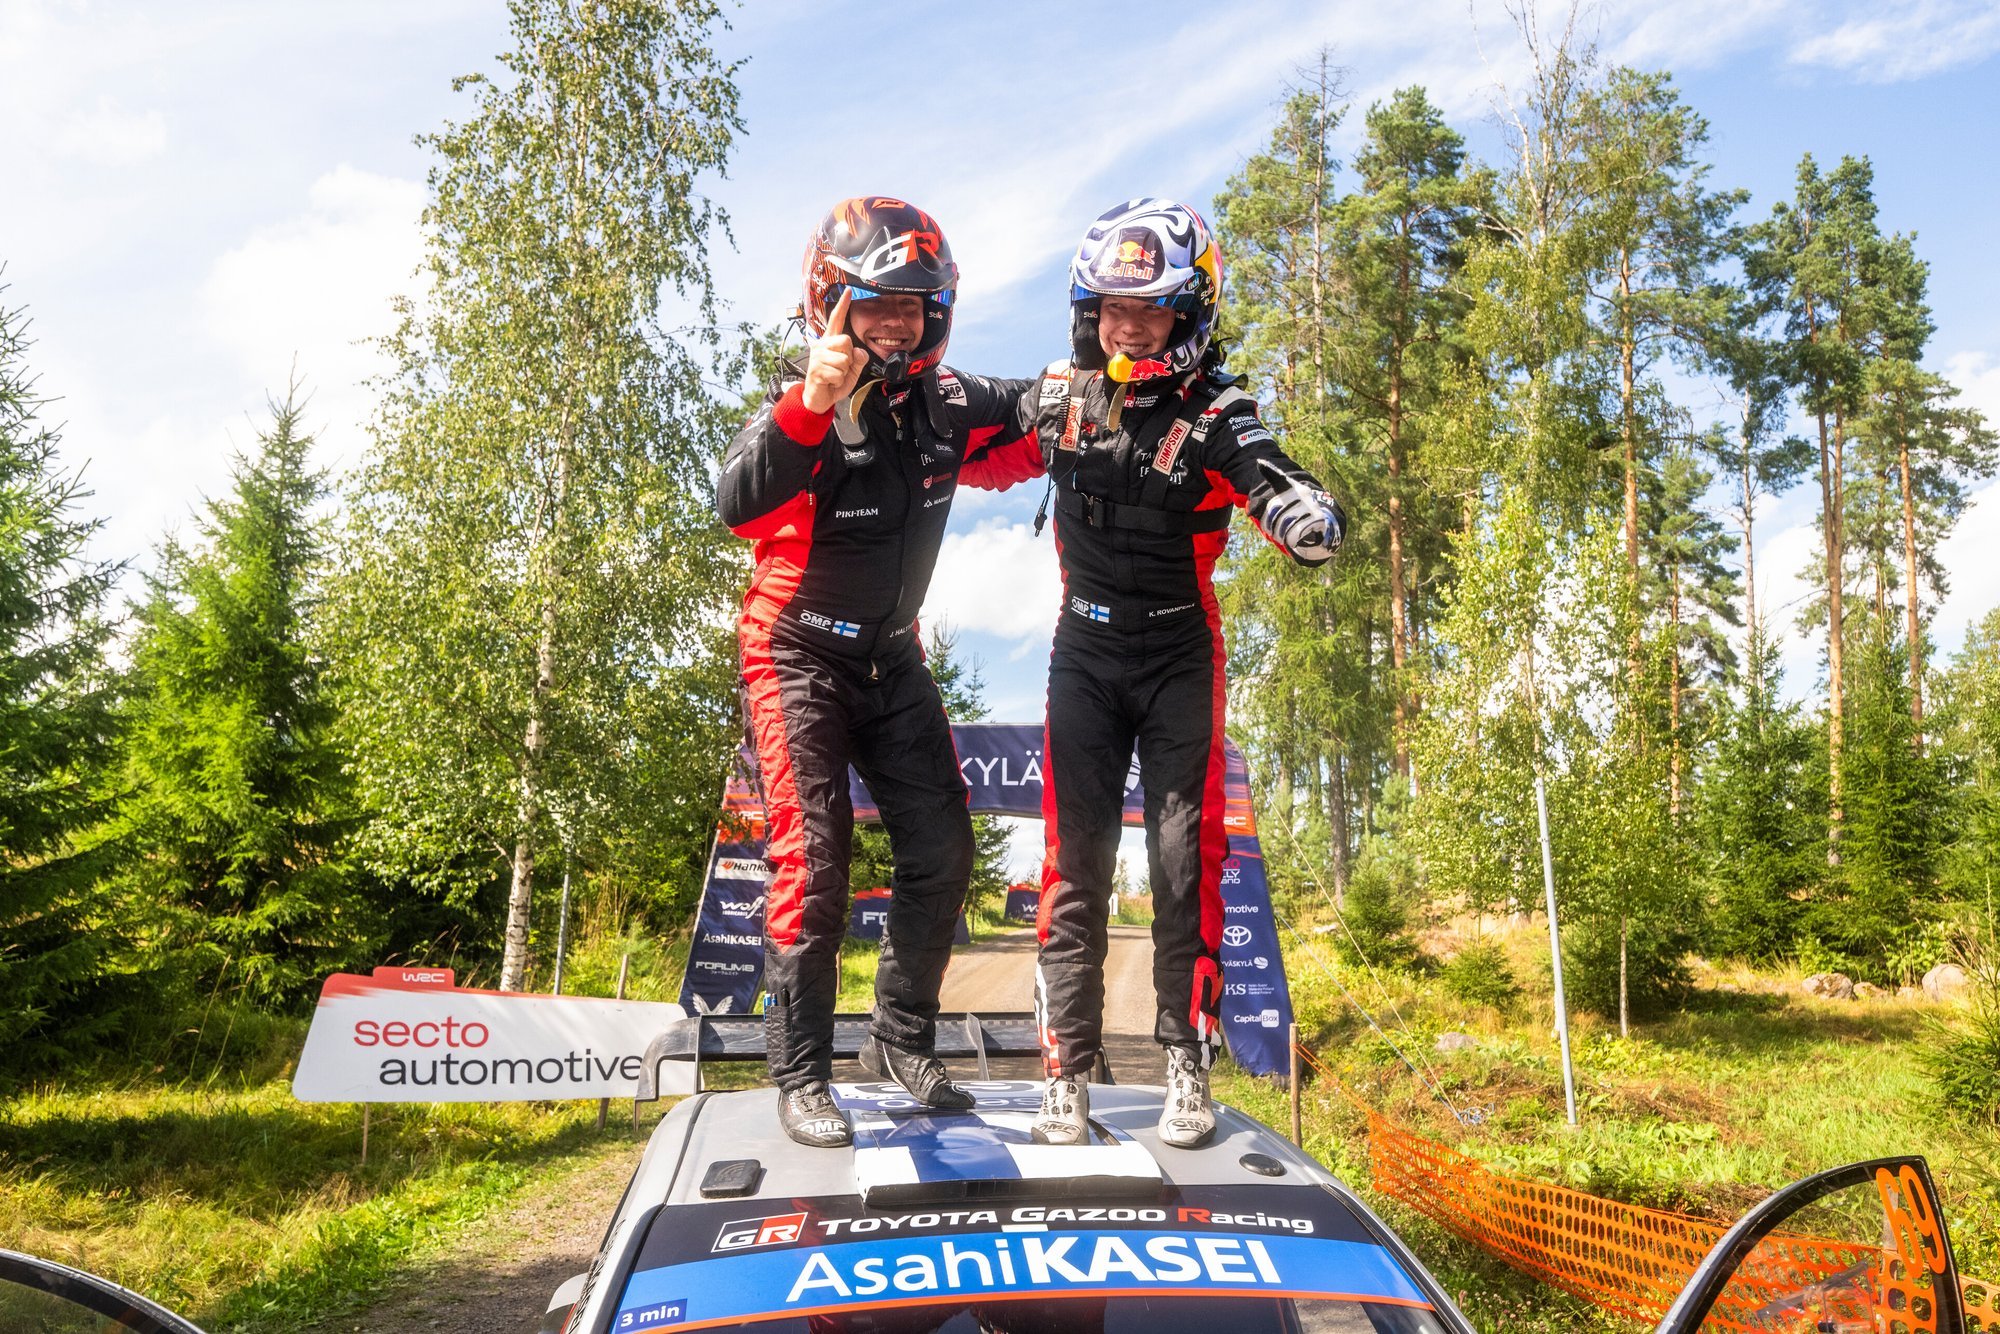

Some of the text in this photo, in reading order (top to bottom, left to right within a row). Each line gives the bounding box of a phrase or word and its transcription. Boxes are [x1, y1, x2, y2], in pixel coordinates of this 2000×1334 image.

[1125, 264, 1154, 281] Bull
[1160, 426, 1183, 467] SIMPSON
[835, 507, 879, 519] PIKI-TEAM
[1071, 598, 1090, 614] OMP
[800, 612, 832, 627] OMP
[702, 933, 763, 946] AsahiKASEI
[402, 972, 446, 983] WRC
[1224, 983, 1246, 996] KS
[354, 1015, 490, 1049] secto
[379, 1048, 643, 1086] automotive
[817, 1206, 1315, 1236] TOYOTA GAZOO Racing
[718, 1224, 800, 1249] GR
[785, 1236, 1283, 1303] AsahiKASEI
[620, 1304, 680, 1327] 3 min
